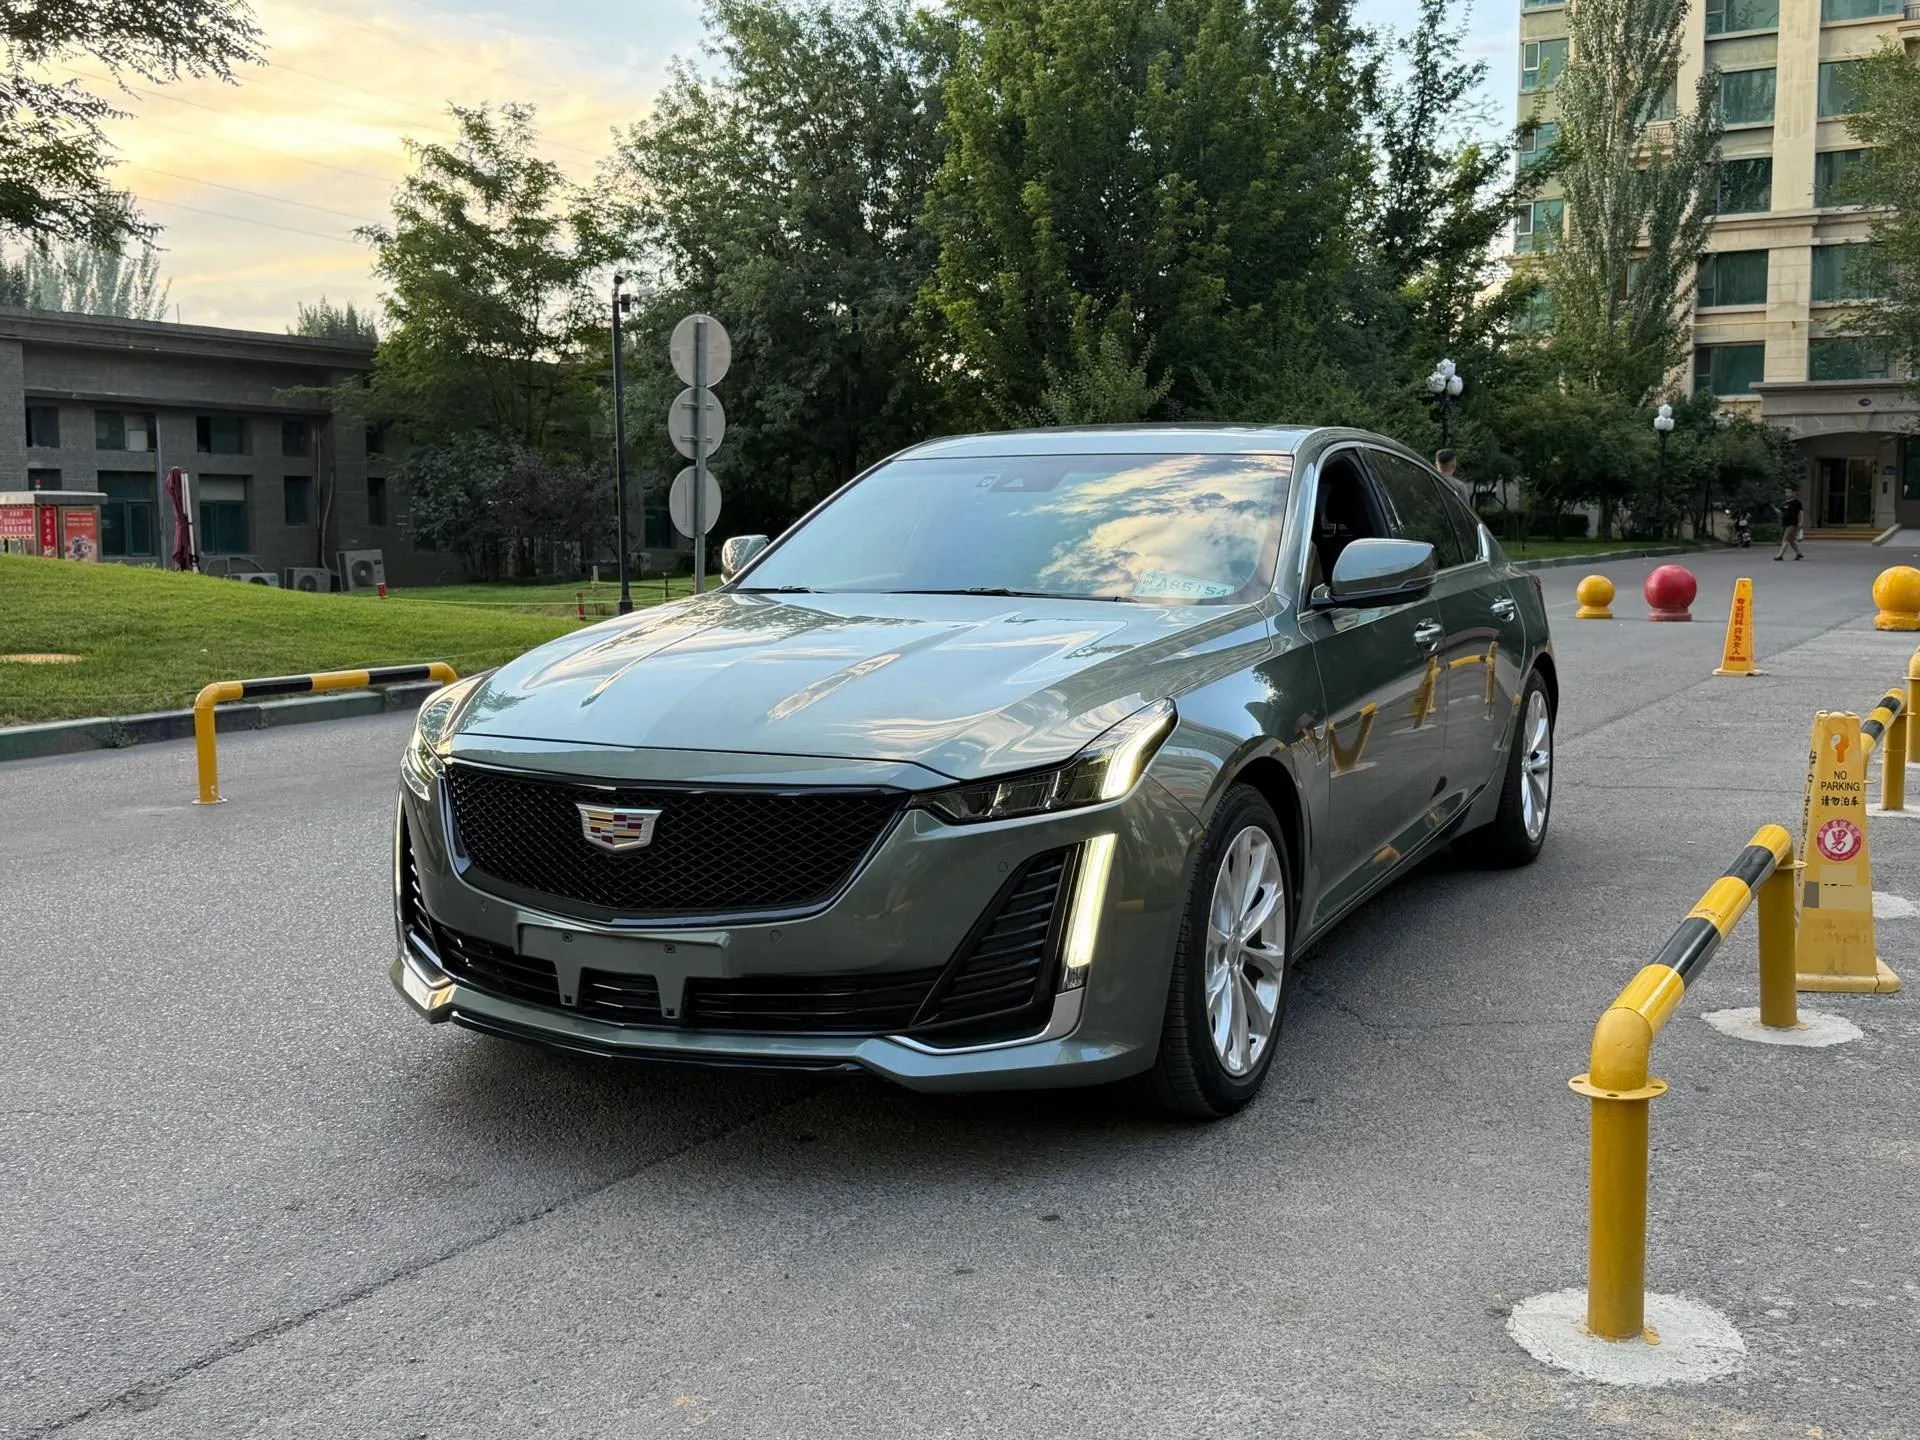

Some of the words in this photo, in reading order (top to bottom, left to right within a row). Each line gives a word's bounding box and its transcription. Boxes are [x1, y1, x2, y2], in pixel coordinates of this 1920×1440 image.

[1833, 770, 1847, 780] NO
[1820, 781, 1860, 791] PARKING
[1820, 795, 1860, 807] 请勿泊车
[1830, 829, 1849, 852] 男
